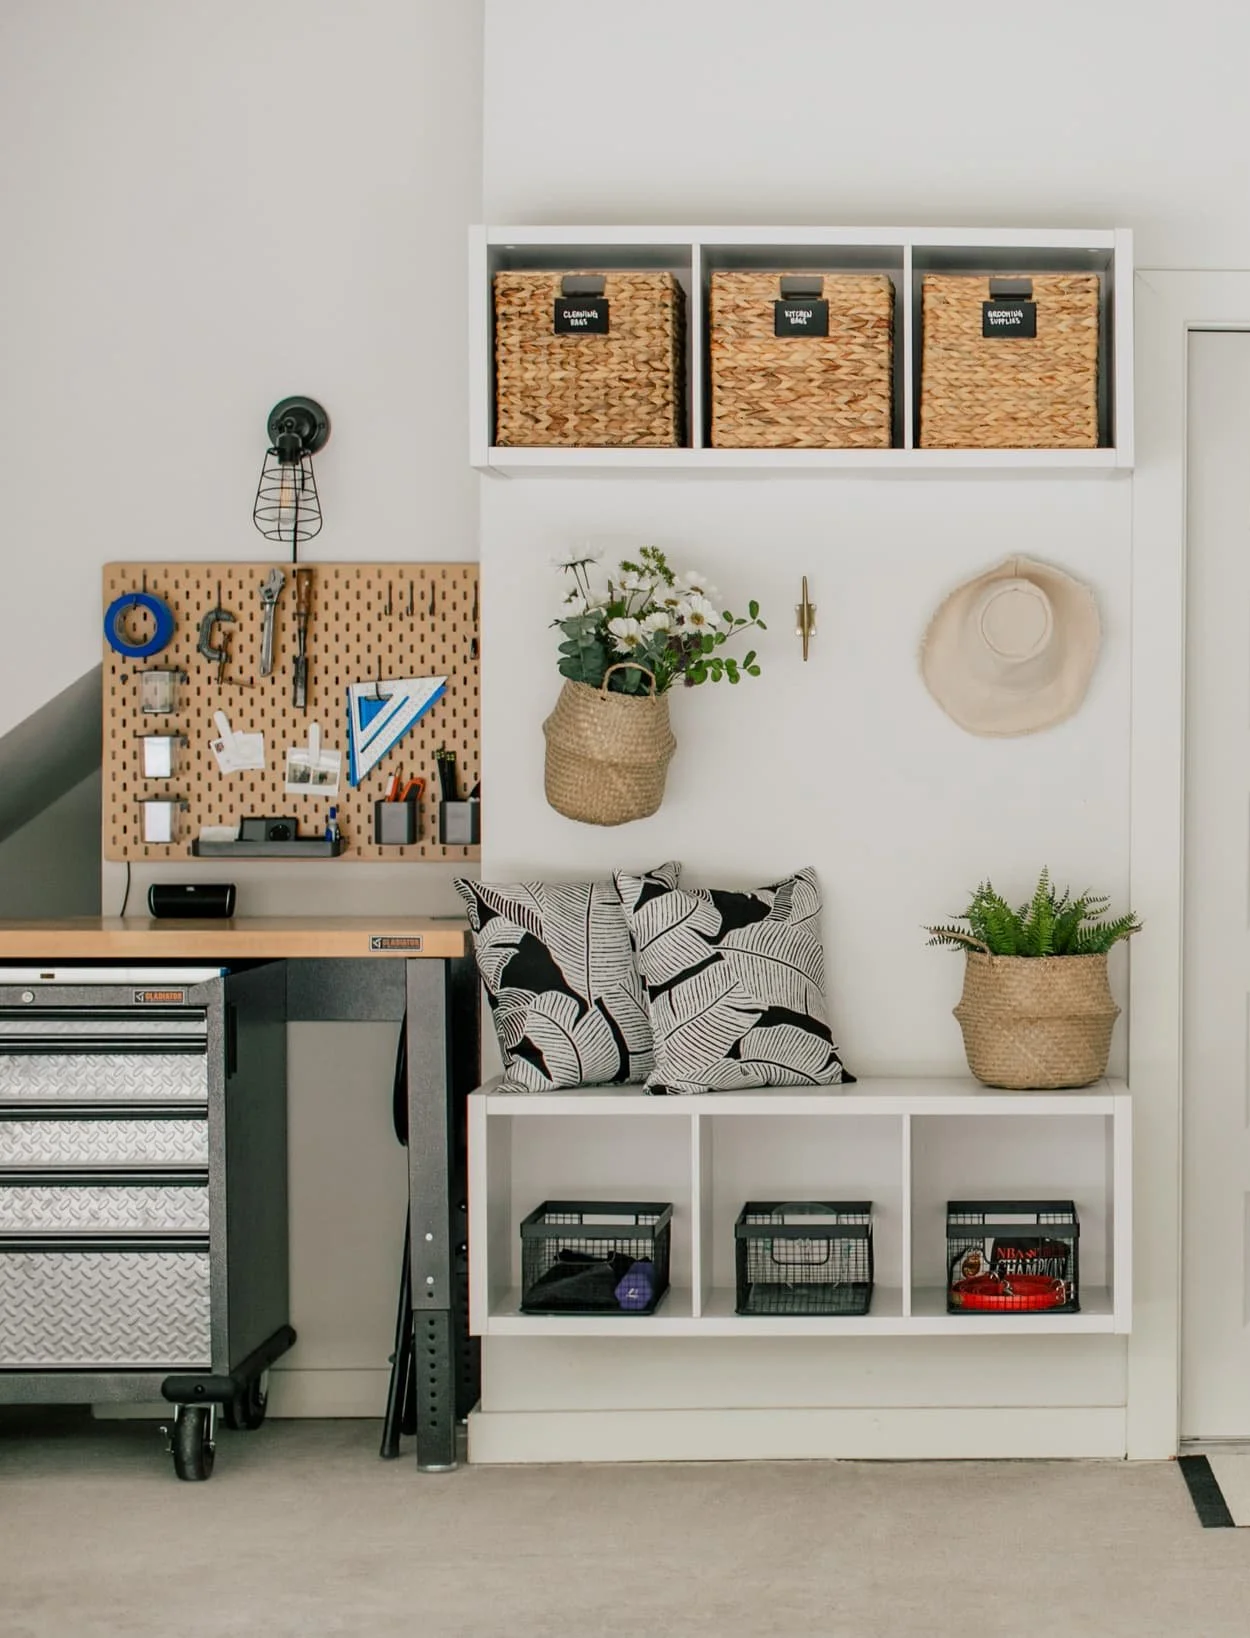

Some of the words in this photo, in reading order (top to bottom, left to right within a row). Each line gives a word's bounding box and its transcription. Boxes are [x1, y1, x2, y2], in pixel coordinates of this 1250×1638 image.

[563, 310, 598, 319] CLEANING
[785, 310, 812, 318] KITCHEN
[988, 310, 1023, 318] GROOMING
[570, 318, 588, 327] BAGS
[996, 1247, 1024, 1259] NBA
